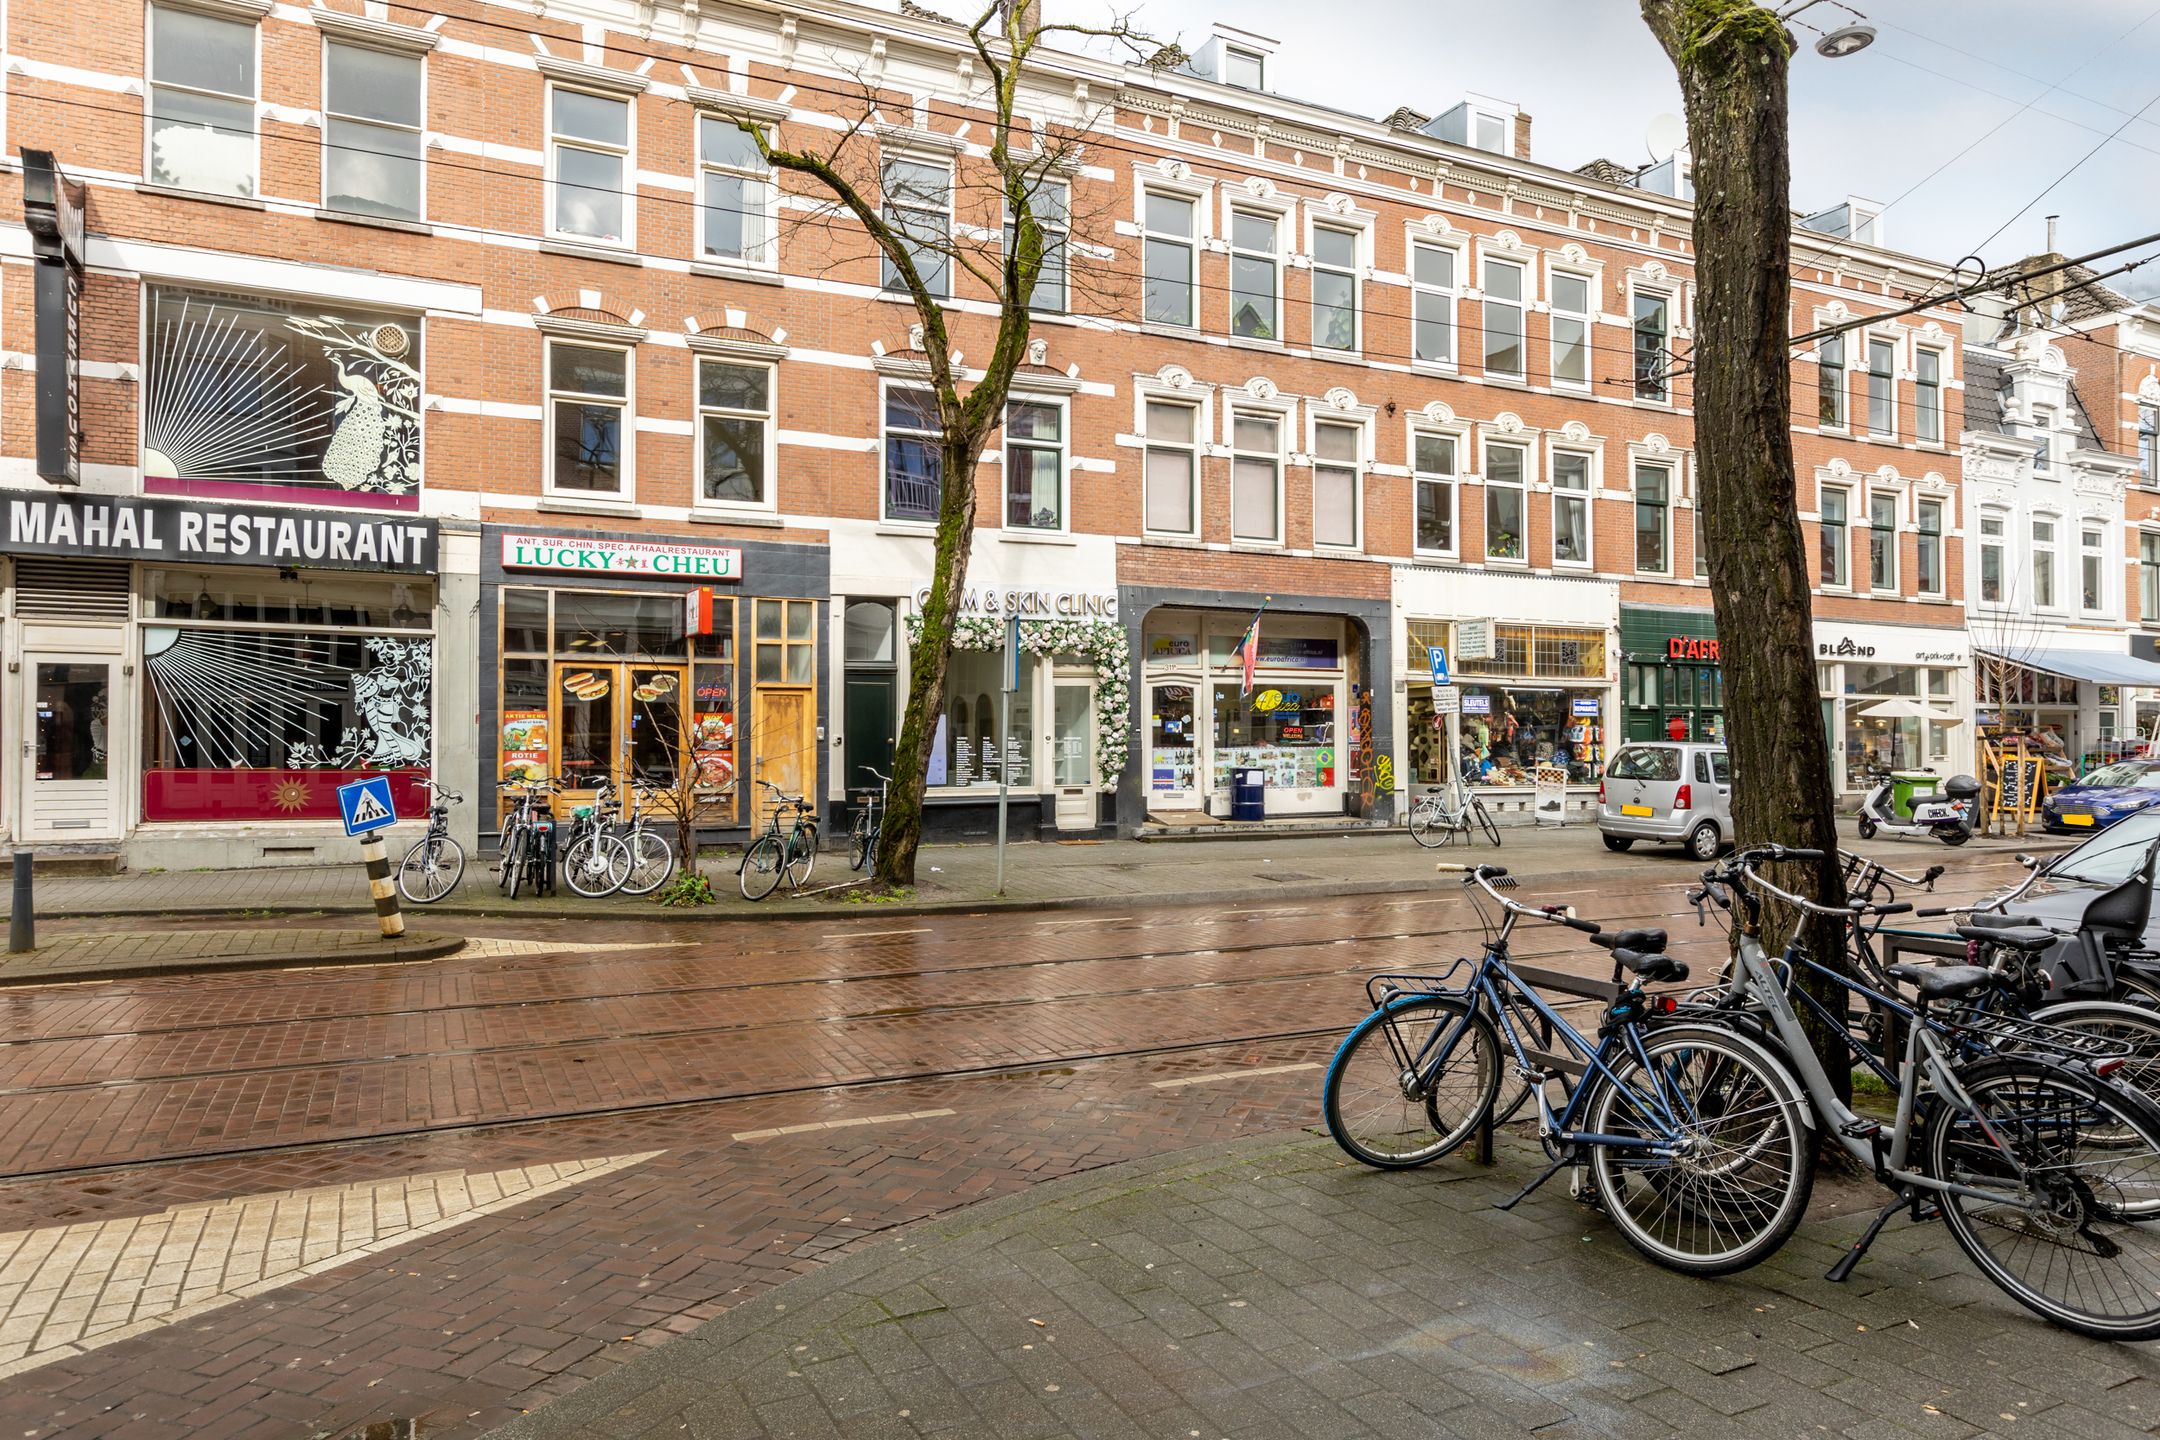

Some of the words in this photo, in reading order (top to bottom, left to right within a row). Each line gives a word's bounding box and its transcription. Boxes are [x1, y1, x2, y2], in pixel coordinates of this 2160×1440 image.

[10, 501, 163, 550] MAHAL
[179, 511, 428, 564] RESTAURANT
[516, 546, 615, 569] LUCKY
[653, 554, 730, 575] CHEU
[542, 538, 566, 547] SUR.
[568, 540, 596, 549] CHIN.
[598, 542, 627, 551] SPEC.
[629, 544, 730, 557] AFHAALRESTAURANT
[985, 589, 999, 610] &
[1007, 590, 1050, 614] SKIN
[1057, 592, 1117, 615] CLINIC
[1168, 640, 1189, 648] euro
[1433, 650, 1442, 669] P
[696, 687, 727, 697] OPEN
[1754, 970, 1782, 1013] ALTEC
[1840, 1032, 1873, 1064] SWAPFIETS
